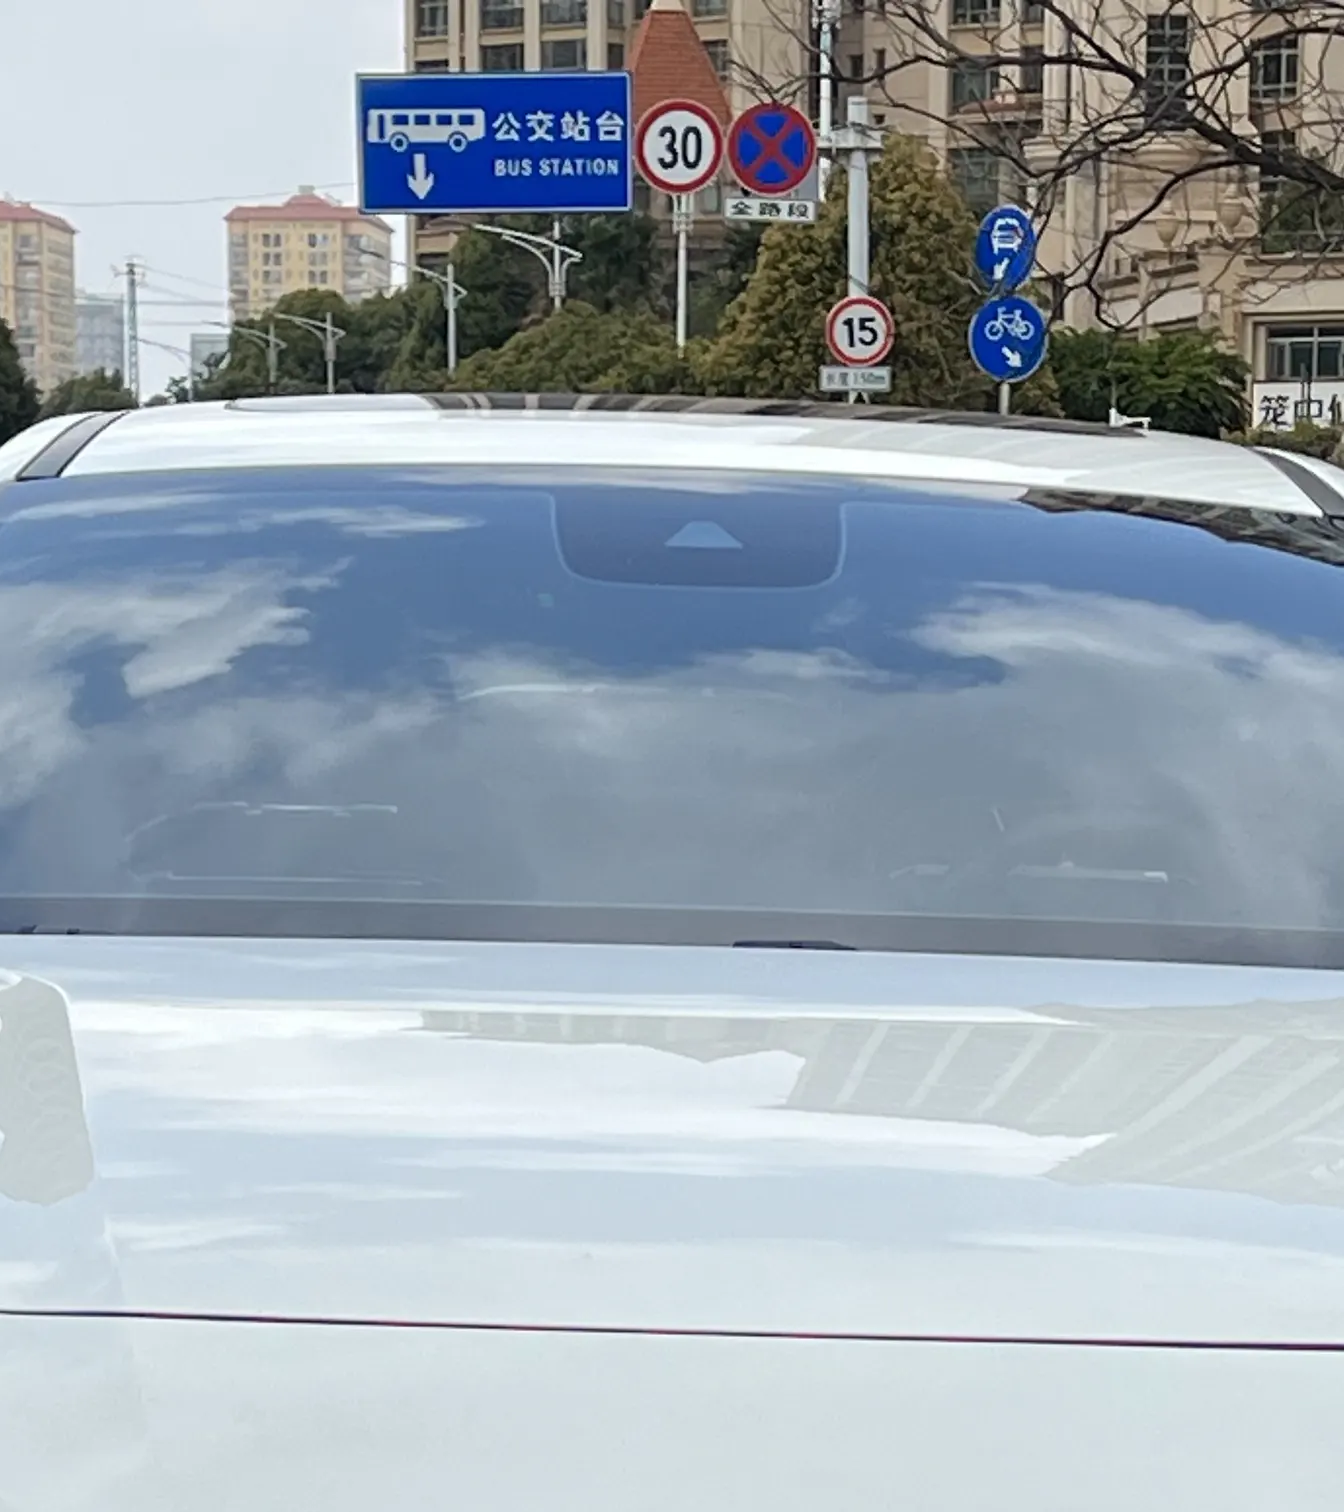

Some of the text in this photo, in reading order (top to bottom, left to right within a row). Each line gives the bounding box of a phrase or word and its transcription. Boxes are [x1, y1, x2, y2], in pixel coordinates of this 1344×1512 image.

[491, 109, 625, 143] 公交站台
[657, 125, 703, 170] 30
[494, 157, 620, 177] BUS STATION
[841, 316, 879, 348] 15
